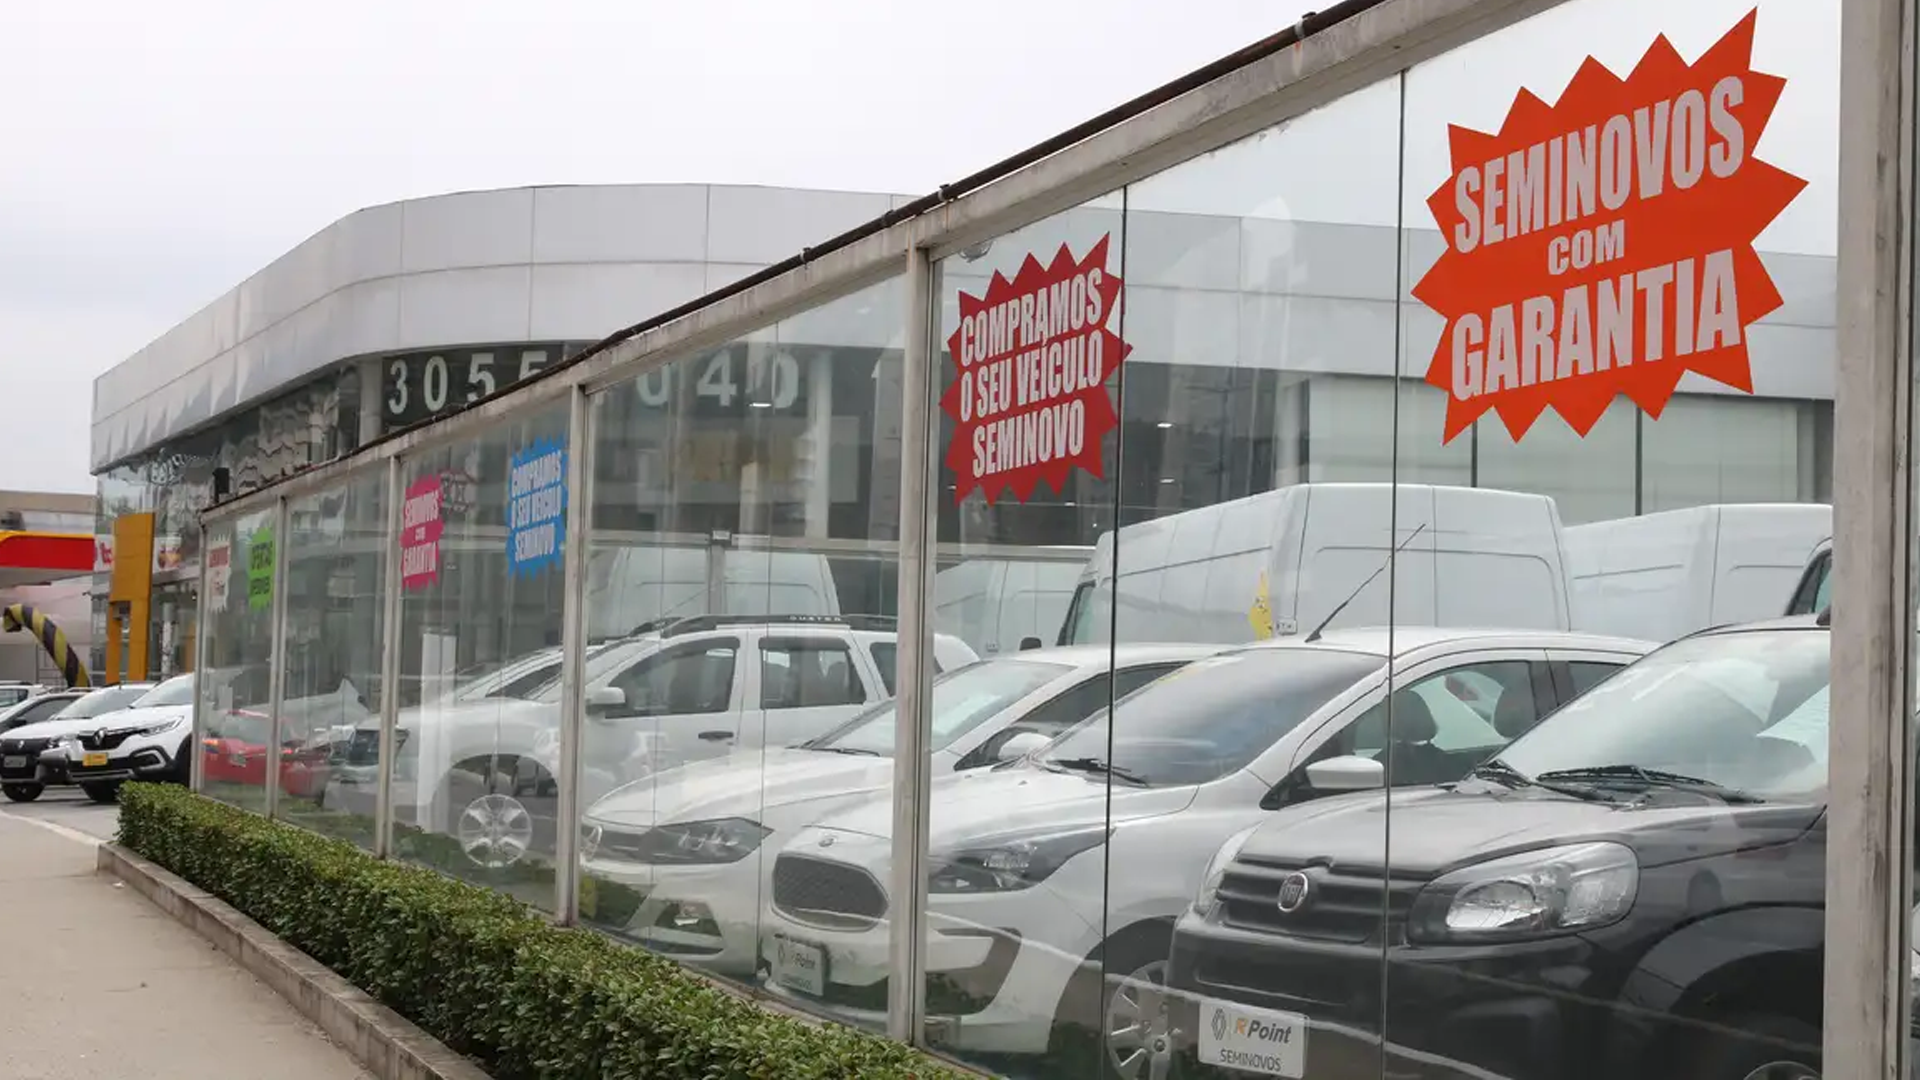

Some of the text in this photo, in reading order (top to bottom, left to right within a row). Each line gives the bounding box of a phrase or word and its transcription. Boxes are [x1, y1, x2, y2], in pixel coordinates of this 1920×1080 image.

[1455, 76, 1744, 253] SEMINOVOS
[1548, 219, 1625, 275] COM
[960, 267, 1102, 367] COMPRAMOS
[1452, 248, 1741, 401] GARANTIA
[960, 329, 1103, 422] O SEU VEÍCULO
[972, 399, 1085, 478] SEMINOVO
[1220, 1049, 1281, 1072] SEMINOVOS
